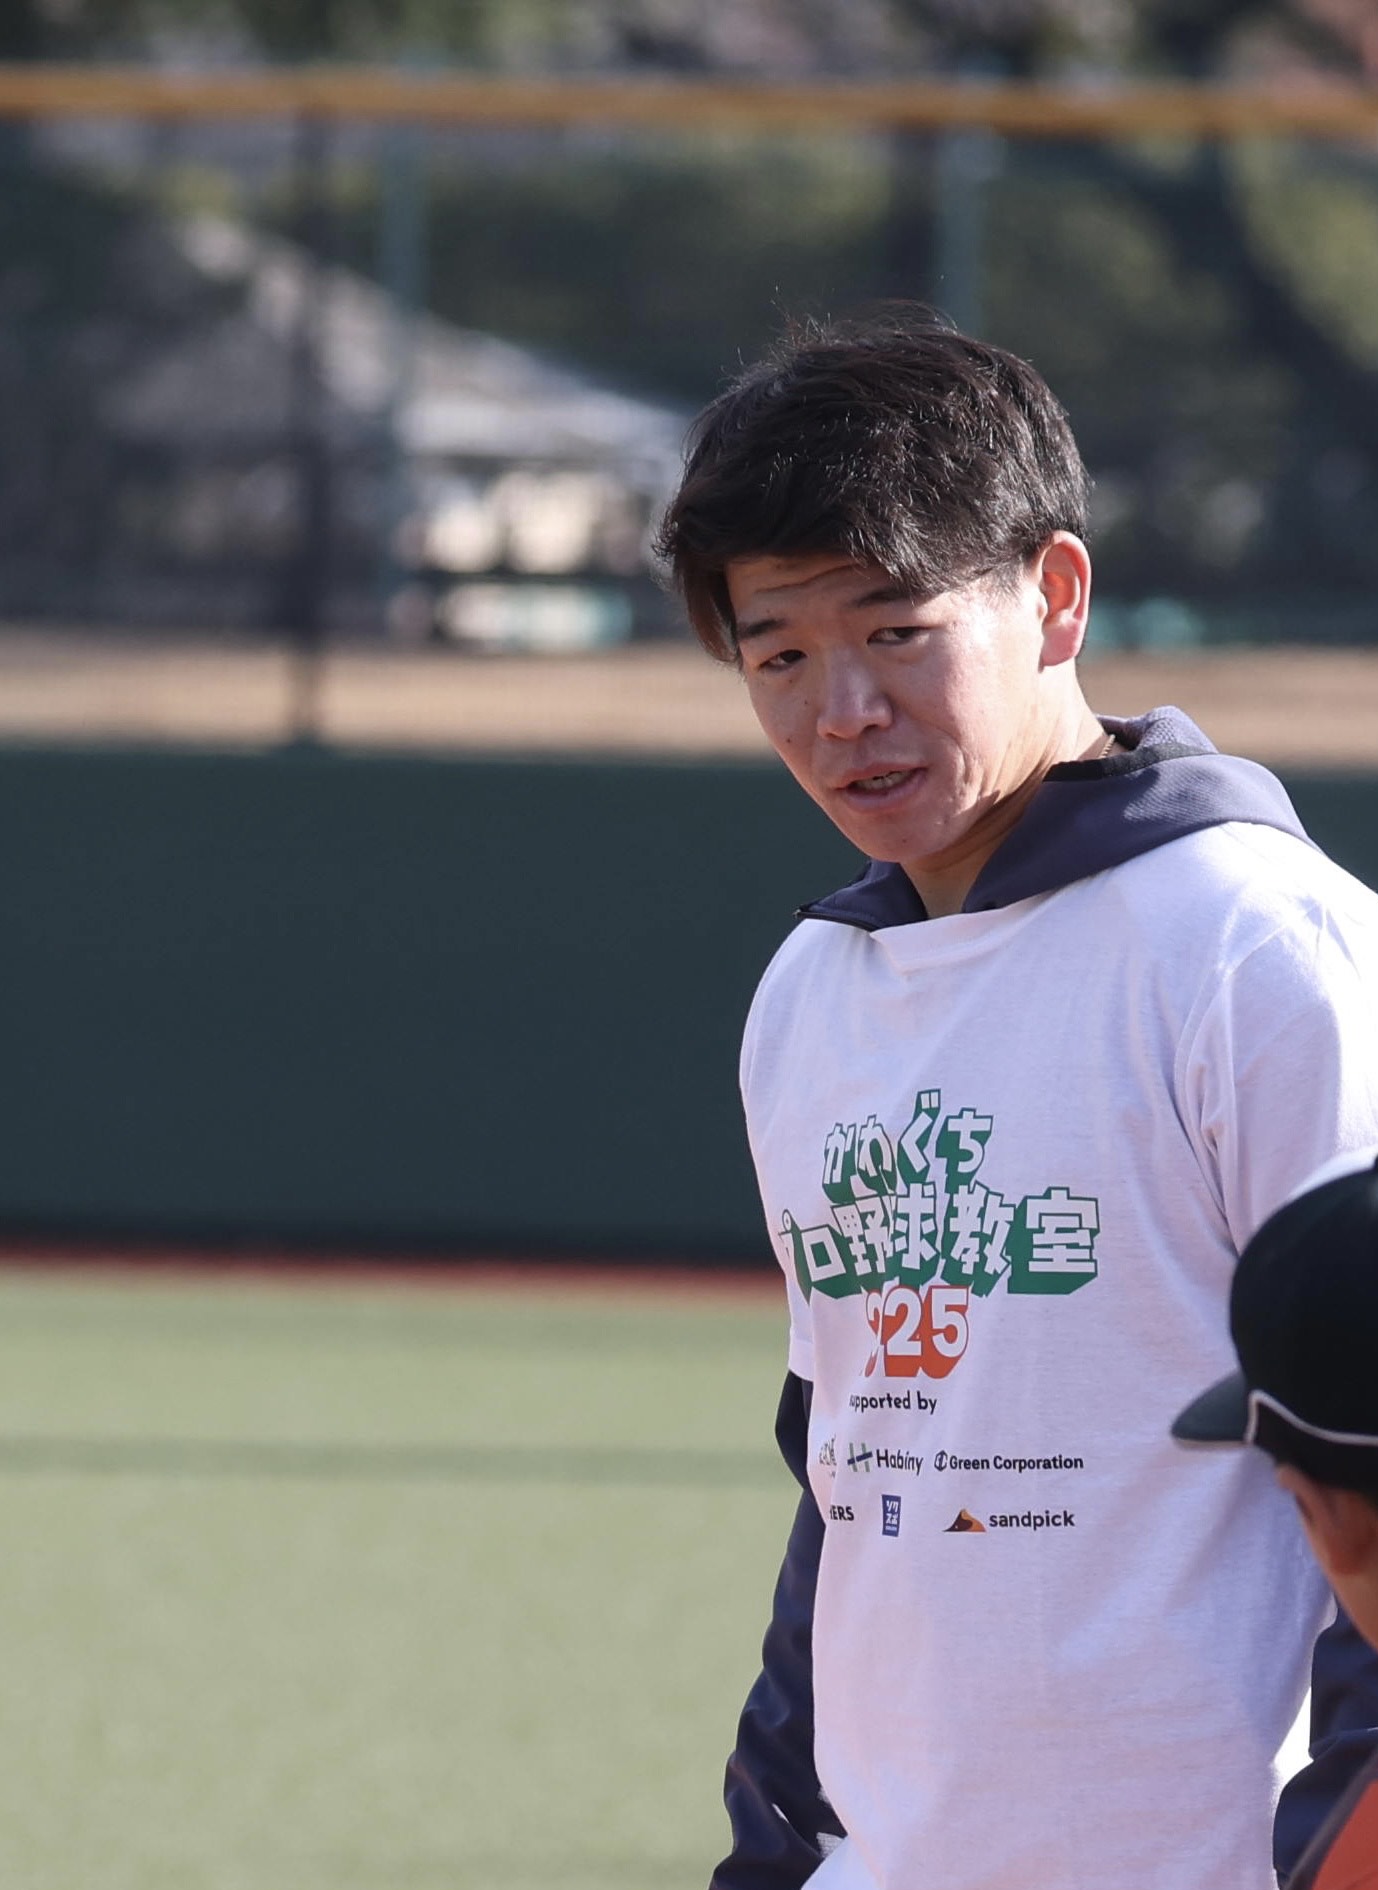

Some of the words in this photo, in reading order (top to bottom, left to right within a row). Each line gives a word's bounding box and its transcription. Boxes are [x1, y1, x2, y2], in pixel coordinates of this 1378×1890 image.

[822, 1088, 994, 1203] かわぐち
[916, 1389, 938, 1416] by
[876, 1448, 924, 1476] Habiny
[949, 1455, 990, 1471] Green
[993, 1454, 1085, 1474] Corporation
[988, 1509, 1076, 1532] sandpick
